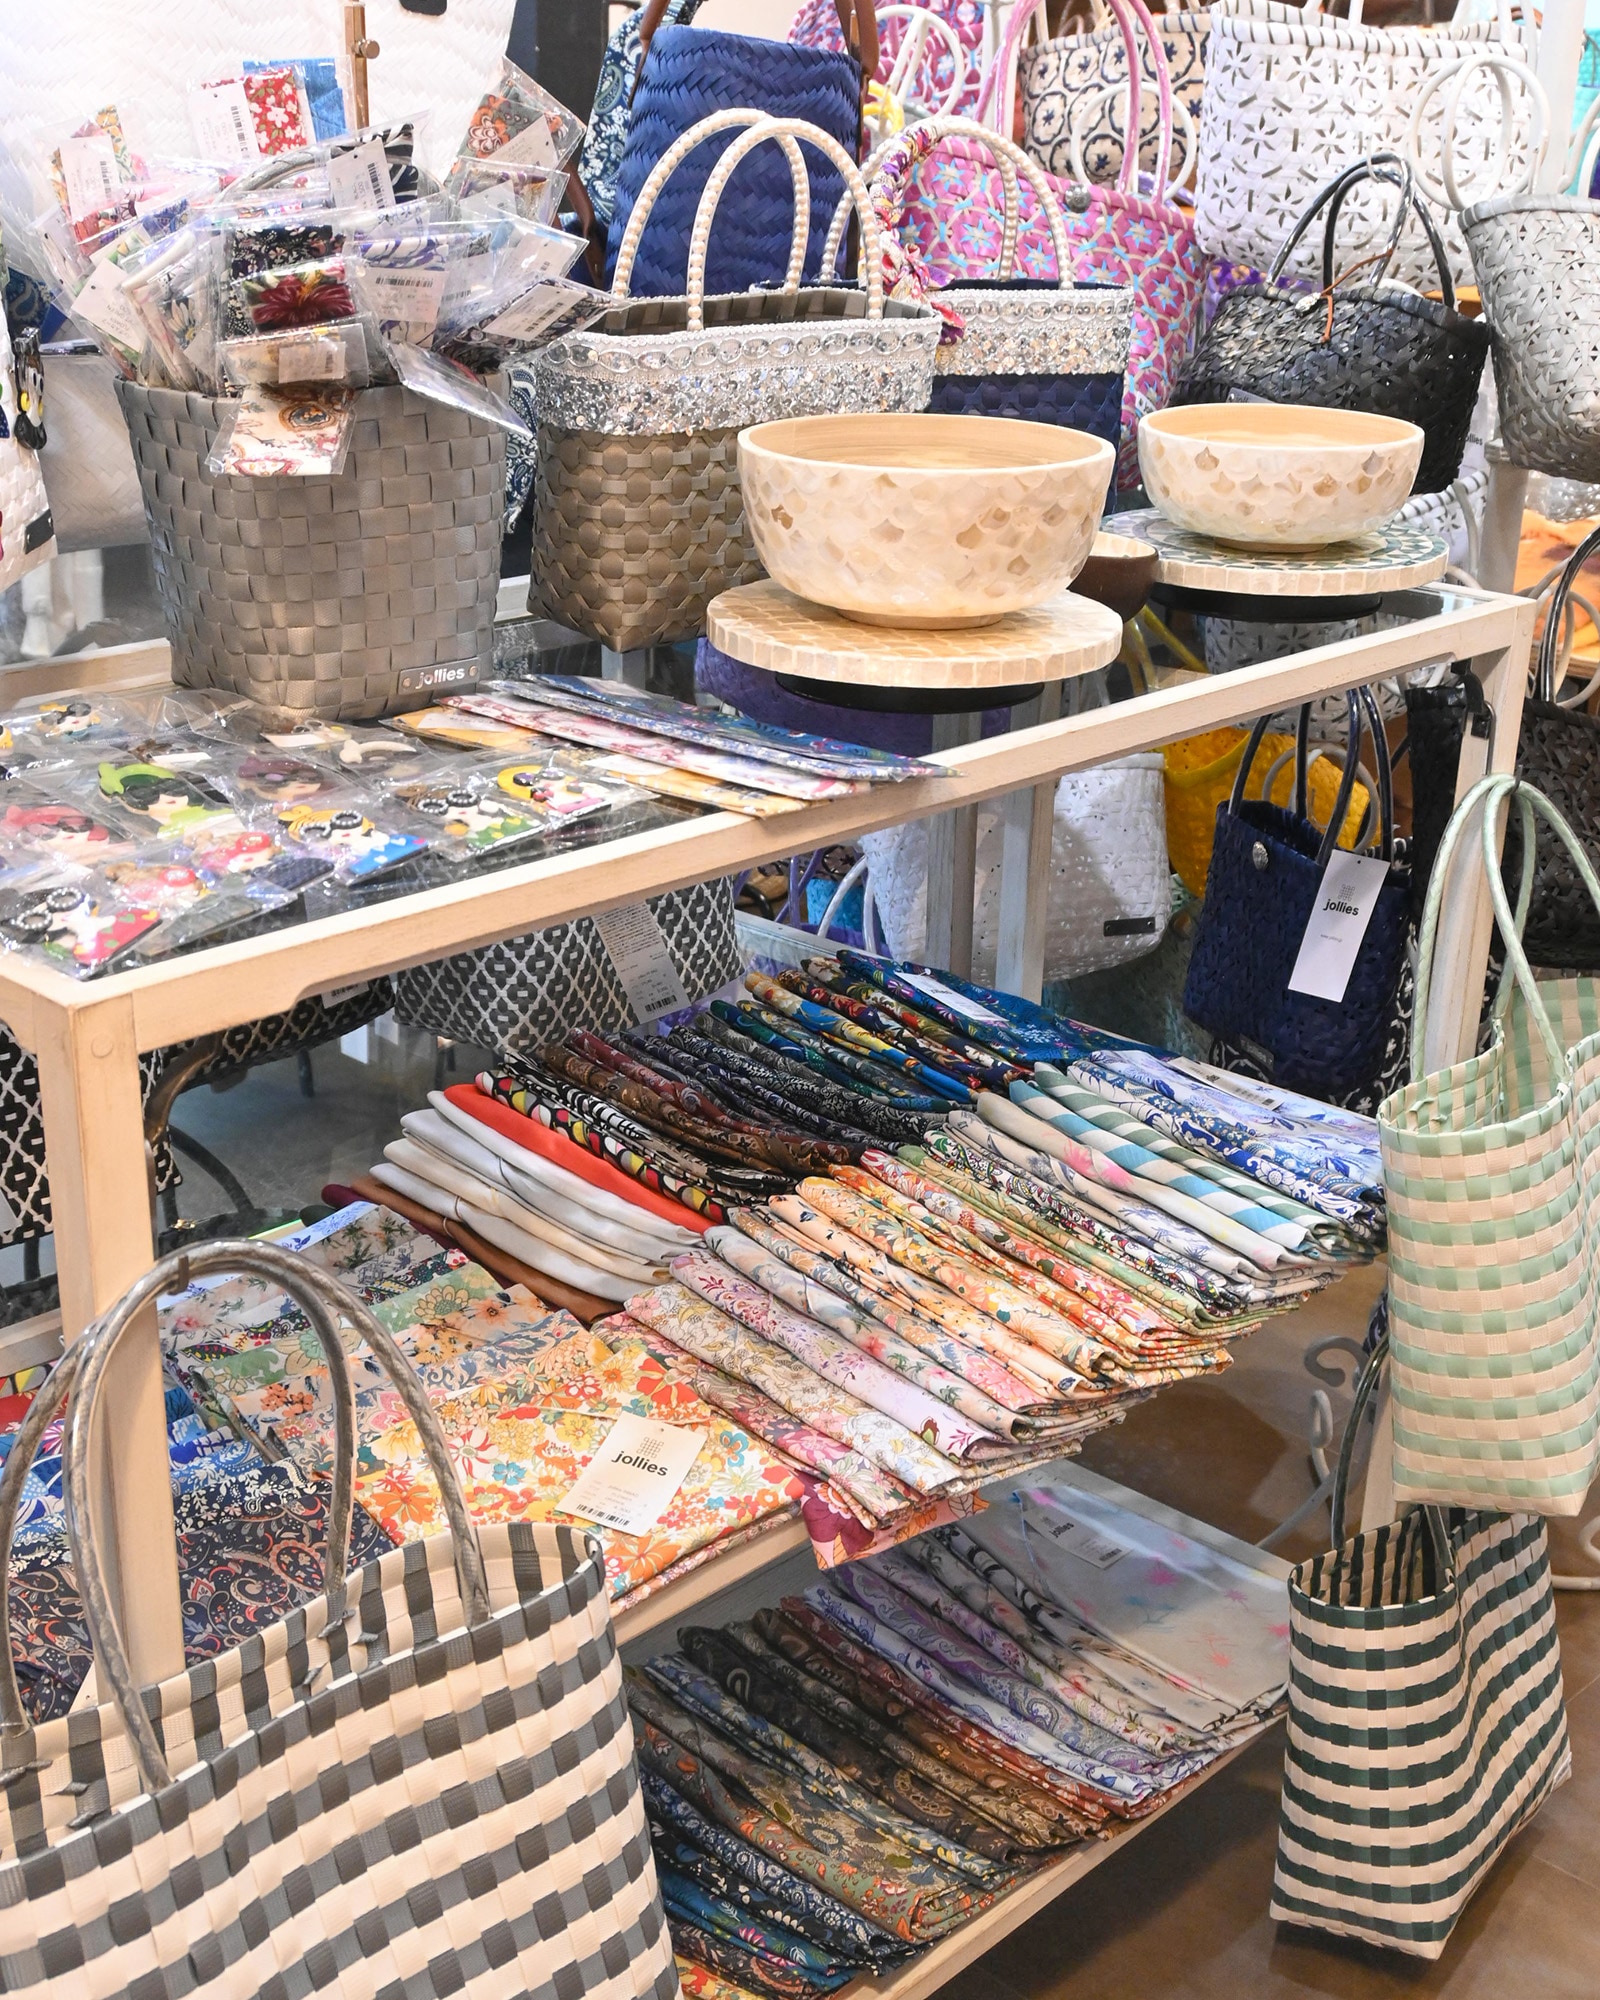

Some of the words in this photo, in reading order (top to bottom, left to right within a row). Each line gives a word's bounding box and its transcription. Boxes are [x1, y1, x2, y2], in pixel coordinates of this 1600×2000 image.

[415, 668, 465, 690] jollies
[1323, 899, 1359, 916] jollies
[611, 1450, 669, 1477] jollies
